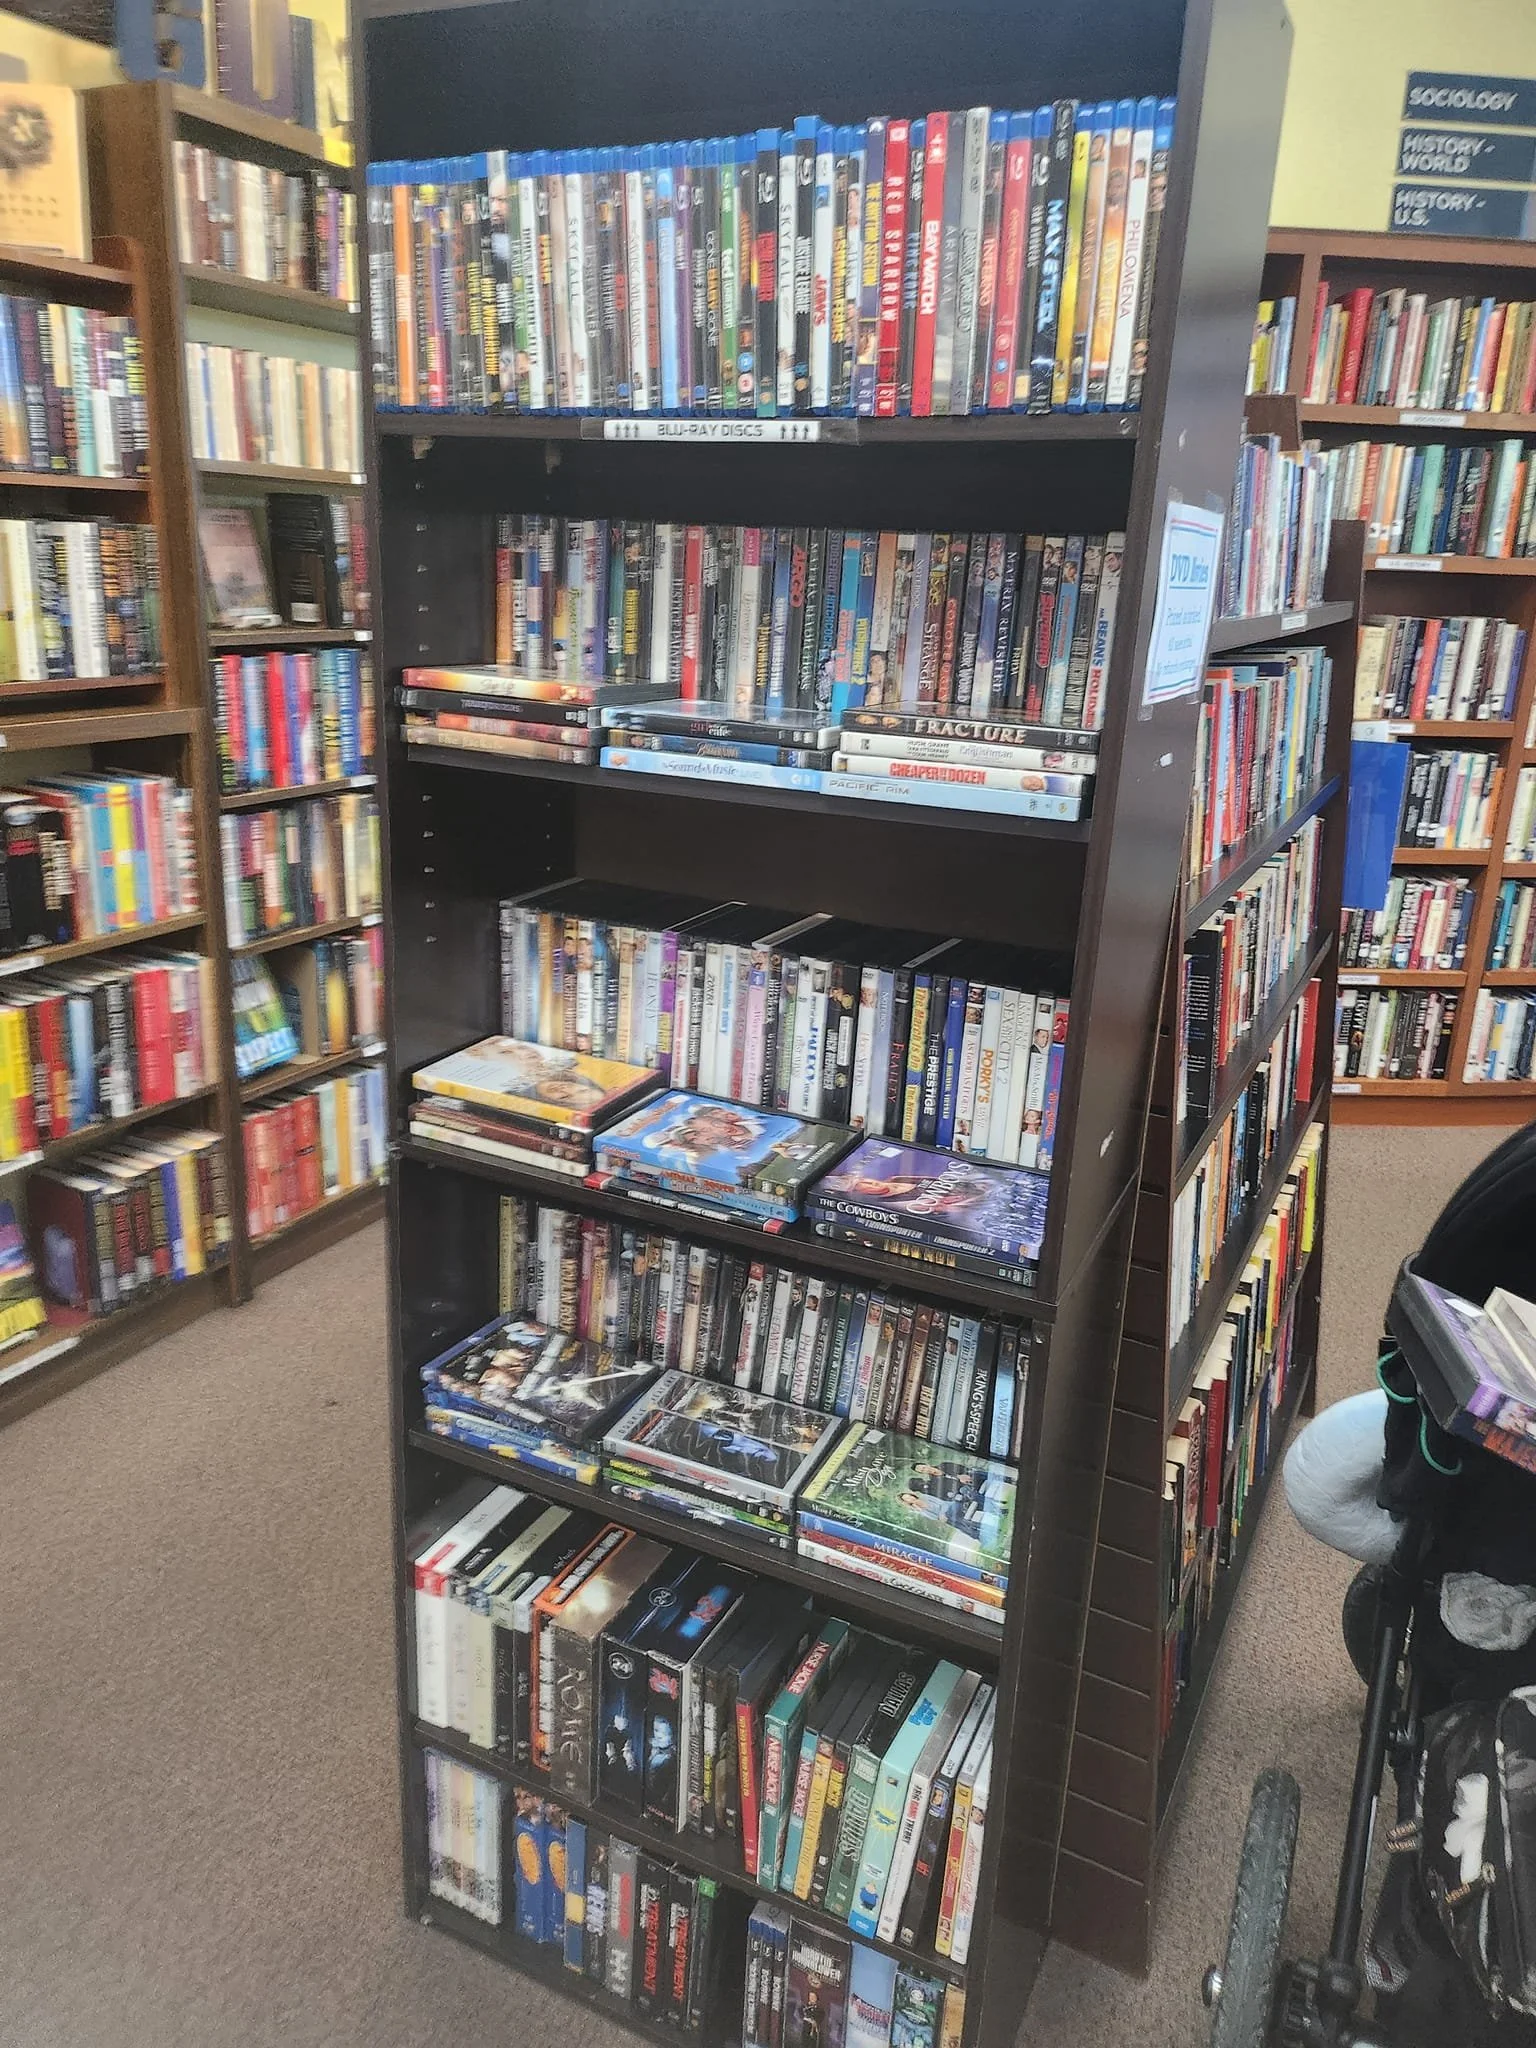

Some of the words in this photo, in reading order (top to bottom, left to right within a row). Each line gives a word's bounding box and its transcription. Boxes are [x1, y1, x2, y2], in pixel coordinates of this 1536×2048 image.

[1408, 87, 1518, 111] SOCIOLOGY
[1402, 154, 1471, 172] WORLD
[1404, 135, 1486, 156] HISTORY
[885, 176, 904, 214] RED
[1396, 190, 1477, 211] HISTORY
[1044, 199, 1064, 257] MAX
[1394, 208, 1429, 226] U.S.
[567, 218, 580, 301] SKYFALL
[704, 231, 717, 268] GONE
[780, 203, 793, 293] SKYFALL
[795, 236, 811, 275] JUSTICE
[905, 232, 920, 268] KING
[941, 225, 957, 303] ARRIVAL
[882, 229, 901, 321] SPARROW
[919, 220, 940, 315] BAYWATCH
[978, 238, 996, 306] INFERNO
[1118, 219, 1141, 320] PHILOMENA
[707, 268, 718, 310] BABY
[795, 275, 810, 315] LEAGUE
[815, 274, 828, 327] JAWS
[903, 271, 918, 309] KONG
[1037, 258, 1057, 333] STEEL
[706, 310, 718, 348] GONE
[657, 424, 719, 435] BLU-RAY
[721, 424, 763, 436] DISCS
[789, 544, 807, 608] ARGO
[805, 542, 819, 601] MATRIX
[826, 532, 841, 594] STOREFRONT
[1170, 553, 1190, 582] DVD
[912, 558, 926, 610] NOTEBOOK
[1001, 551, 1018, 611] MATRIX
[606, 617, 622, 654] crash
[684, 613, 698, 659] VINNY
[823, 594, 839, 648] HITCHCOCK
[837, 609, 847, 653] CAPTAIN
[943, 598, 957, 661] COYOTE
[800, 605, 816, 691] REVOLUTIONS
[919, 622, 937, 691] STRANGE
[992, 617, 1009, 693] REVISITED
[1010, 646, 1023, 676] FRIDA
[1091, 620, 1109, 667] BEAN'S
[769, 635, 783, 698] IRRESISTIBLE
[957, 668, 974, 703] WORLD
[1064, 686, 1085, 710] STORY
[914, 719, 1026, 743] FRACTURE
[828, 779, 879, 793] PACIFIC
[885, 786, 911, 795] RIM
[889, 762, 939, 781] CHEAPER
[950, 769, 986, 785] DOZEN
[692, 989, 702, 1024] jackass
[705, 974, 715, 1006] ZORBA
[916, 989, 927, 1008] The
[879, 991, 889, 1033] NOTEBOOK
[912, 1009, 926, 1042] March
[1002, 1000, 1015, 1023] SEX
[1015, 1001, 1027, 1049] INNOCENT
[690, 1025, 700, 1039] the
[825, 1029, 838, 1052] JACK
[928, 1032, 939, 1056] THE
[967, 1040, 975, 1052] AS
[689, 1039, 699, 1065] movie
[910, 1055, 921, 1070] On
[965, 1052, 974, 1075] GOOD
[997, 1041, 1009, 1074] CITY
[823, 1052, 837, 1090] REACHER
[888, 1041, 905, 1103] FRAILTY
[923, 1056, 938, 1116] PRESTIGE
[964, 1076, 972, 1085] AS
[977, 1049, 994, 1104] PORKY'S
[997, 1076, 1008, 1085] 2
[942, 1094, 950, 1119] VIETNAM
[960, 1093, 970, 1114] GETS
[906, 1160, 971, 1214] COWBOYS
[819, 1198, 835, 1207] THE
[836, 1201, 899, 1224] COWBOYS
[864, 1219, 923, 1239] TRANSPORTER
[933, 1235, 990, 1254] TRANSPORTER
[560, 1258, 578, 1303] MOULIN
[655, 1308, 667, 1343] MEANS
[700, 1303, 712, 1332] STILL
[654, 1343, 665, 1362] WAR
[832, 1346, 841, 1359] MAN
[963, 1327, 973, 1344] THE
[860, 1355, 873, 1385] BRIDGET
[959, 1346, 970, 1374] BLIND
[870, 1365, 885, 1403] MOTORCYCLE
[920, 1385, 935, 1405] BEAT
[971, 1373, 987, 1409] KING'S
[914, 1415, 930, 1439] DEVIL
[965, 1411, 981, 1451] SPEECH
[873, 1542, 933, 1566] MIRACLE
[651, 1589, 671, 1607] 24
[610, 1654, 632, 1674] 24
[805, 1642, 831, 1671] NURSE
[787, 1664, 816, 1696] JACKIE
[877, 1671, 917, 1718] DALLAS
[555, 1663, 587, 1765] ROME
[766, 1737, 781, 1770] NURSE
[765, 1769, 780, 1805] JACKIE
[795, 1760, 812, 1789] NURSE
[792, 1788, 806, 1818] JACKIE
[906, 1800, 919, 1819] BANG
[838, 1789, 870, 1862] DALLAS
[901, 1818, 915, 1844] THEORY
[643, 1902, 660, 1995] TREATMENT
[673, 1916, 689, 2002] TREATMENT
